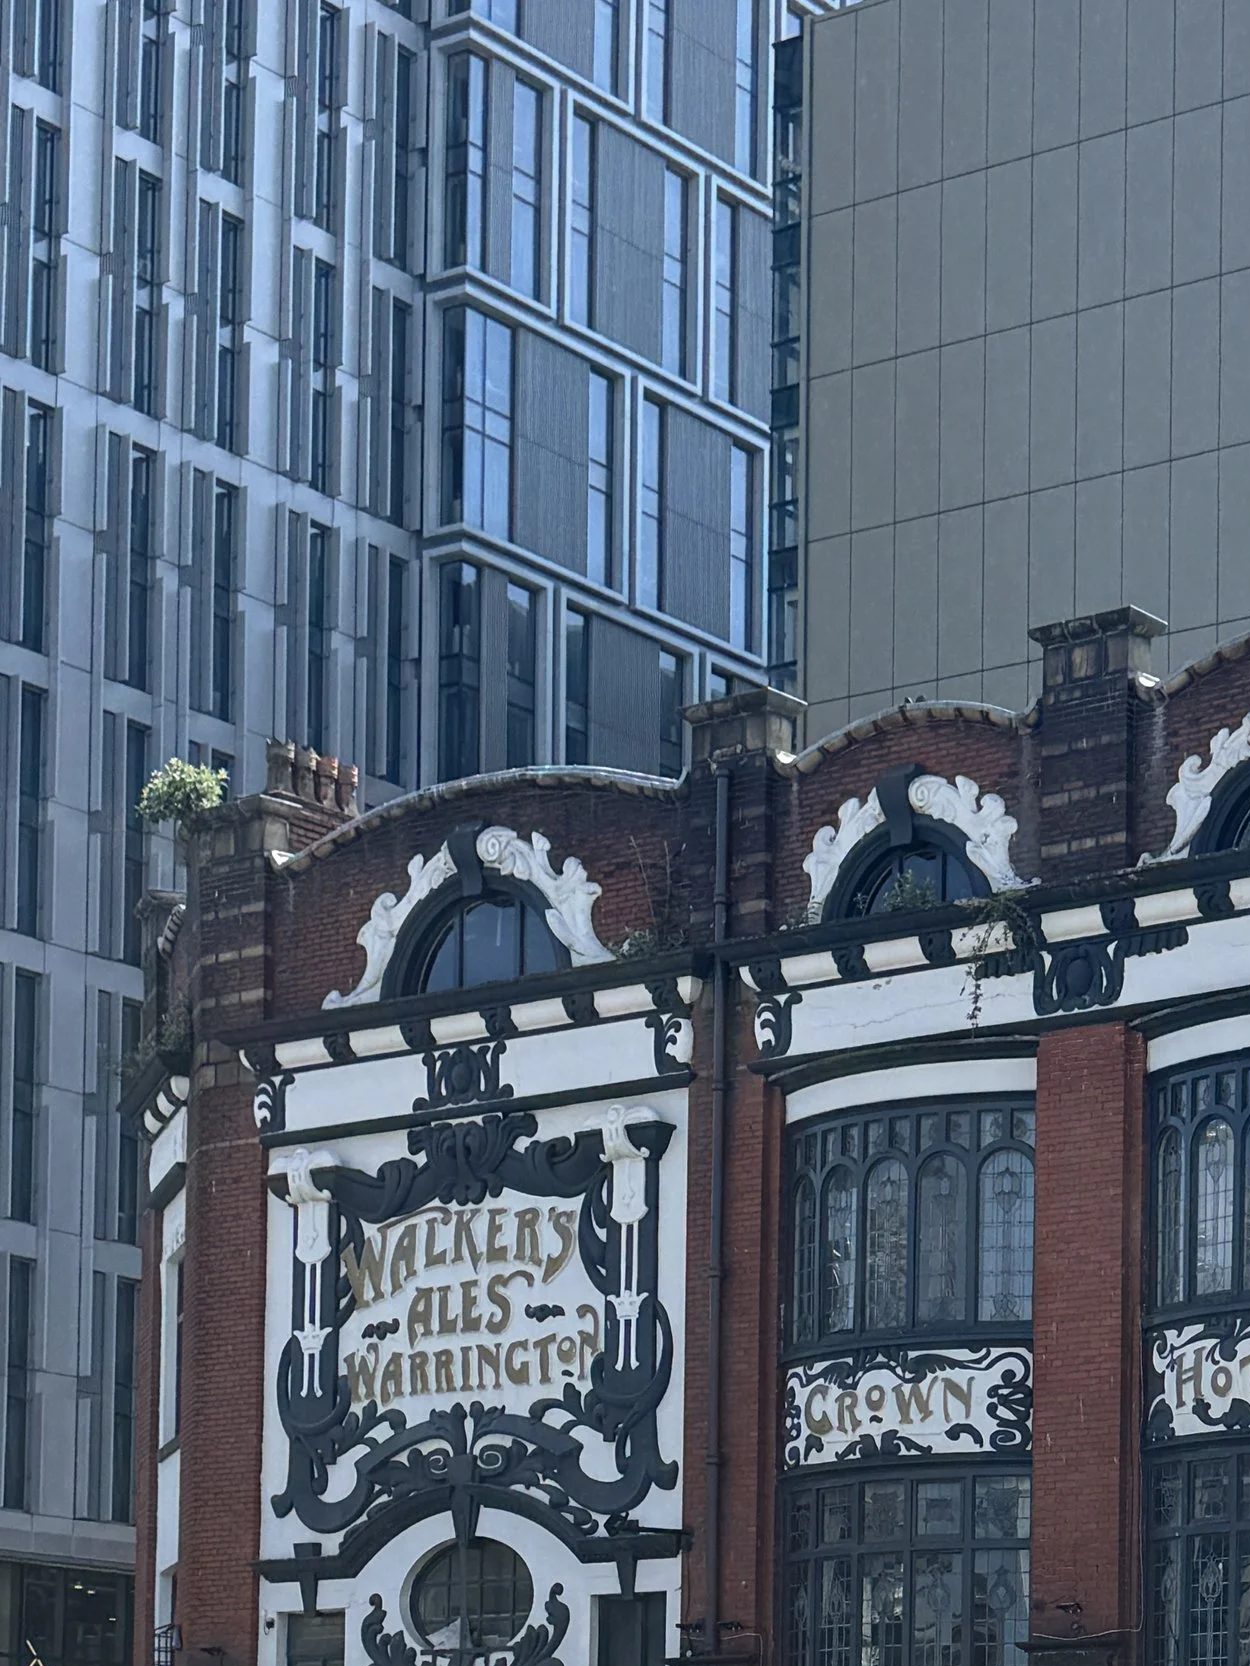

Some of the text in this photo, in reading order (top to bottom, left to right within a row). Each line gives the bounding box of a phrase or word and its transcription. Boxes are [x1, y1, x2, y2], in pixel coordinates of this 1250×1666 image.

[341, 1205, 578, 1309] WALKER'S
[407, 1270, 535, 1349] ALES
[344, 1304, 601, 1406] WARRINGTON
[804, 1376, 976, 1436] CROWN
